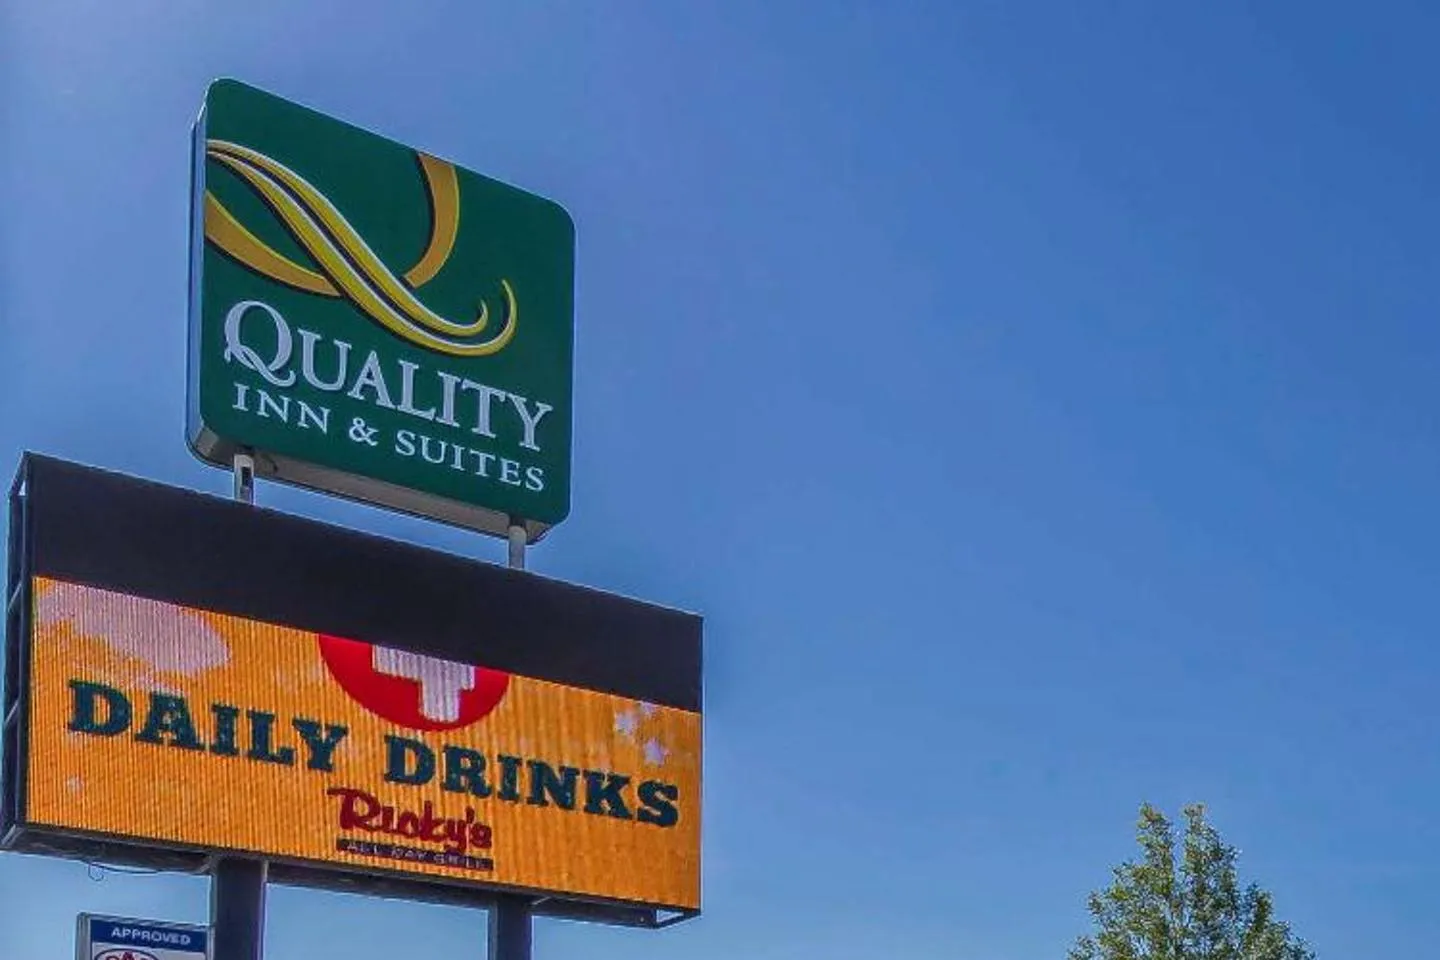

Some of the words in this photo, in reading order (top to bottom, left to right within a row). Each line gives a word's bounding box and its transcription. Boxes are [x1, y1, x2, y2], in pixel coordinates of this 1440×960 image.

[223, 300, 553, 452] QUALITY
[232, 383, 330, 434] INN
[348, 417, 379, 447] &
[395, 429, 545, 492] SUITES
[67, 678, 349, 773] DAILY
[383, 734, 680, 828] DRINKS
[326, 786, 493, 857] Ricky's
[111, 927, 192, 946] APPROVED
